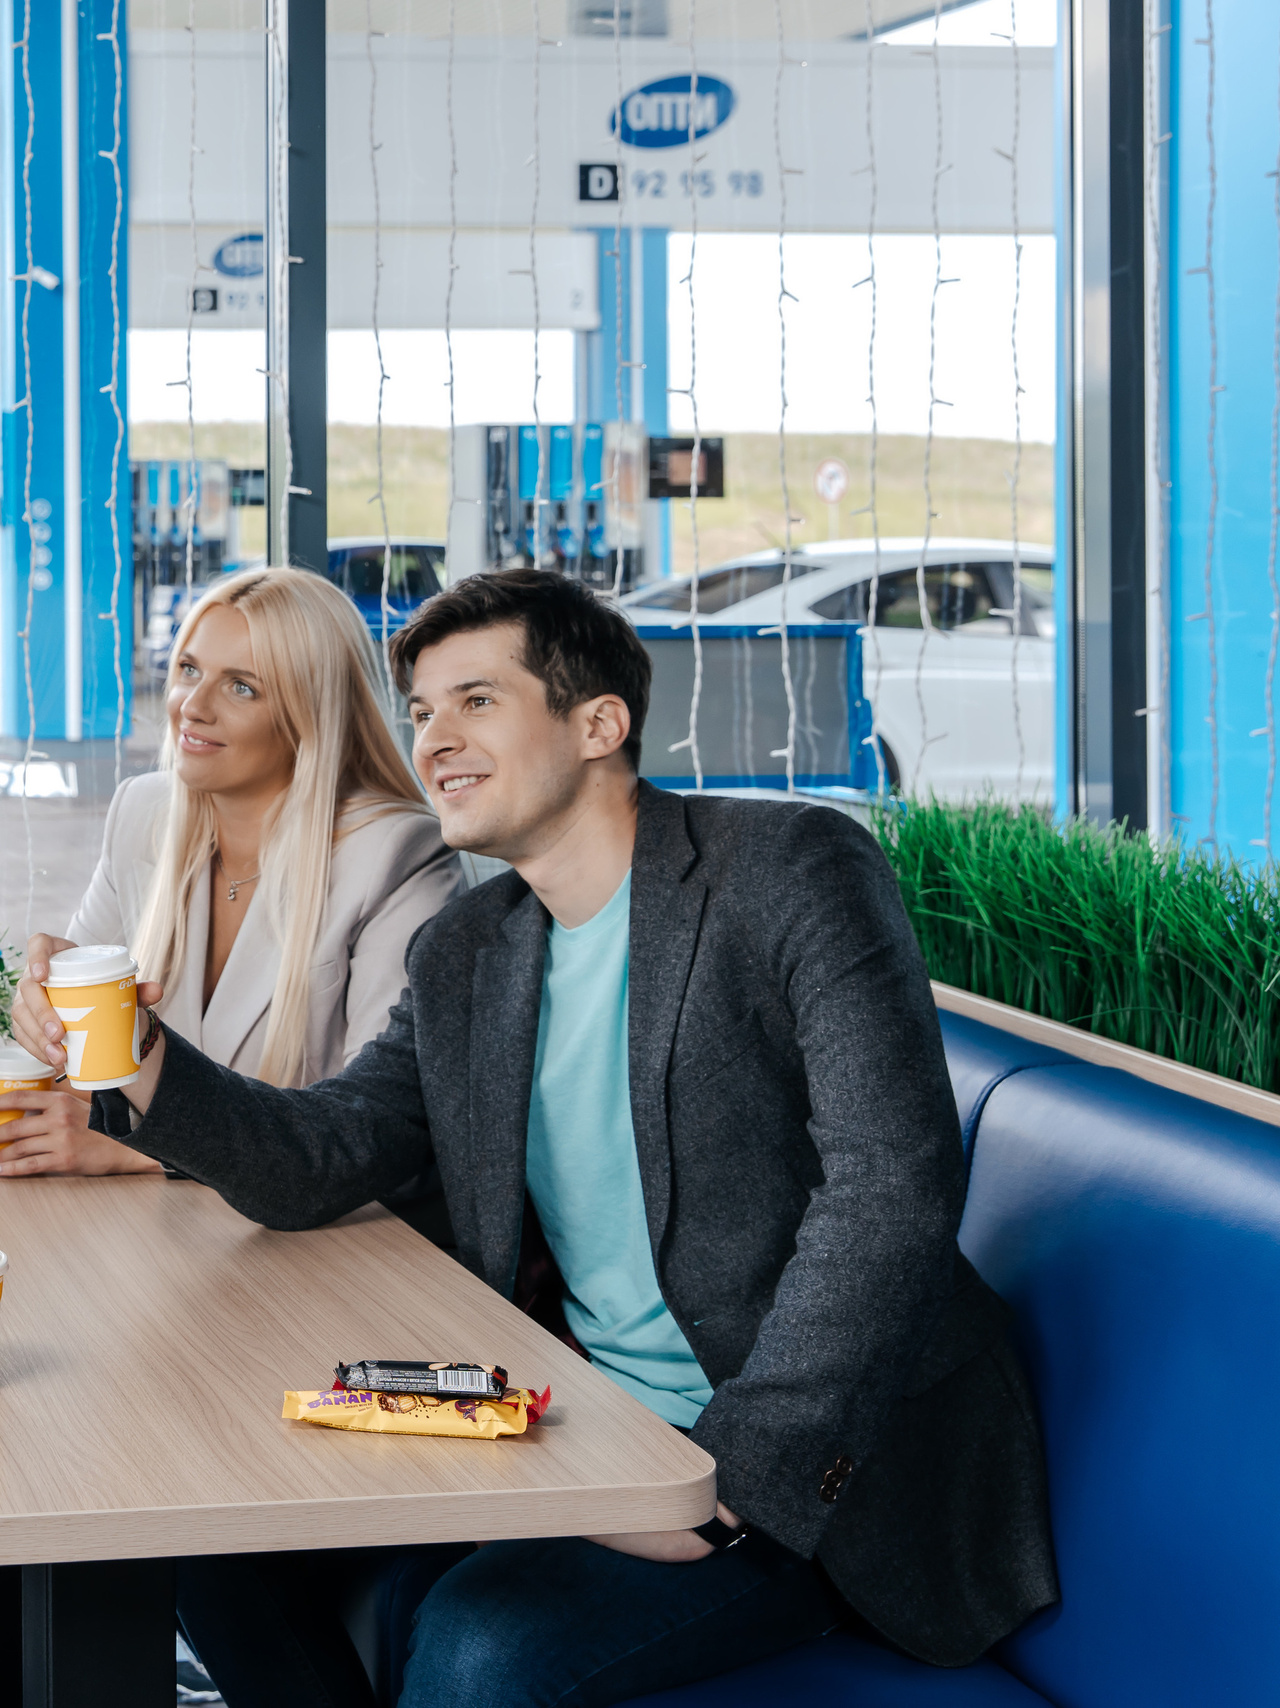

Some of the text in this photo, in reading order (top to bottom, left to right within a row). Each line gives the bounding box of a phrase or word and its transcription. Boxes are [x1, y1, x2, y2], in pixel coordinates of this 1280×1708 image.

[588, 166, 764, 199] D 92 95 98
